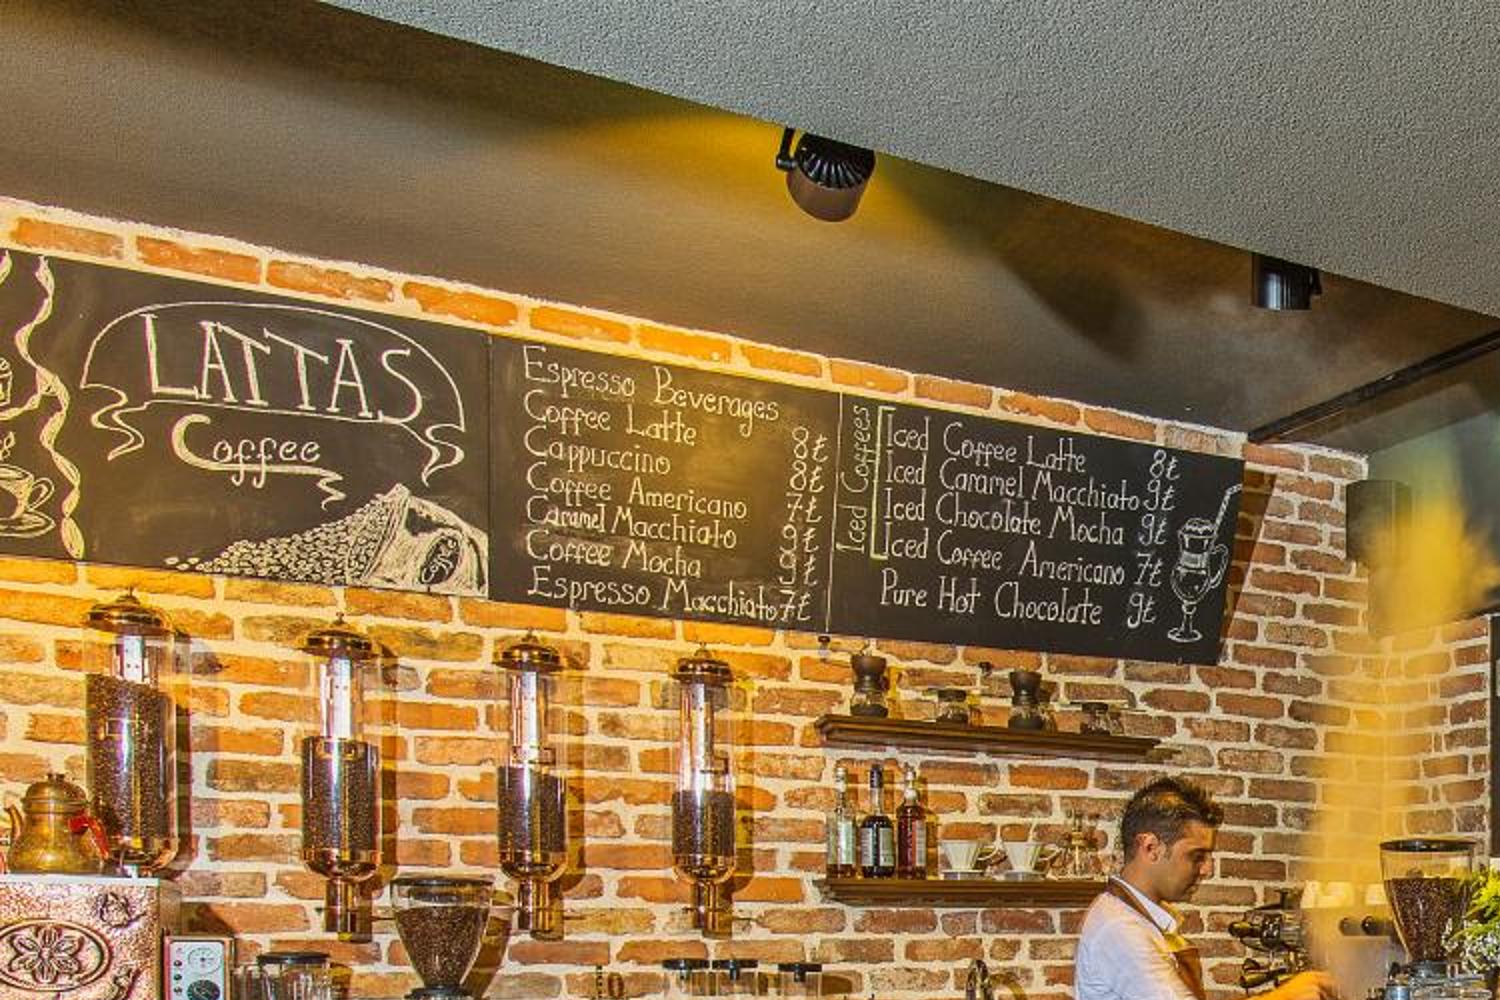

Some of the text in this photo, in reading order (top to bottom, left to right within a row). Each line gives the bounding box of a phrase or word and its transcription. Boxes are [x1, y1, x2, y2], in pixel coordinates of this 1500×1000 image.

[140, 314, 423, 423] LATTAS
[523, 345, 779, 437] Espresso Beverages
[523, 389, 611, 436] Coffee
[626, 404, 697, 447] Latte
[886, 414, 929, 451] Iced
[943, 422, 1017, 469] Coffee
[1026, 436, 1087, 473] Latte
[171, 414, 324, 489] Coffee
[524, 425, 671, 475] Cappuccino
[527, 462, 611, 506] Coffee
[629, 477, 747, 519] Americano
[836, 405, 871, 555] Iced Coffees
[884, 450, 925, 486] Iced
[939, 458, 1024, 499] Caramel
[1031, 473, 1141, 512] Macchiato
[527, 495, 605, 533] Caramel
[611, 506, 736, 549] Macchiato
[884, 488, 925, 522] Iced
[936, 493, 1041, 536] Chocolate
[1047, 505, 1124, 546] Mocha
[526, 530, 611, 567] Coffee
[622, 542, 701, 578] Mocha
[884, 522, 928, 560] Iced
[937, 530, 1001, 574] Coffee
[1019, 542, 1125, 586] Americano
[528, 565, 650, 612] Espresso
[658, 579, 776, 621] Macchiato
[880, 568, 927, 608] Pure
[938, 576, 981, 615] Hot
[994, 582, 1102, 625] Chocolate
